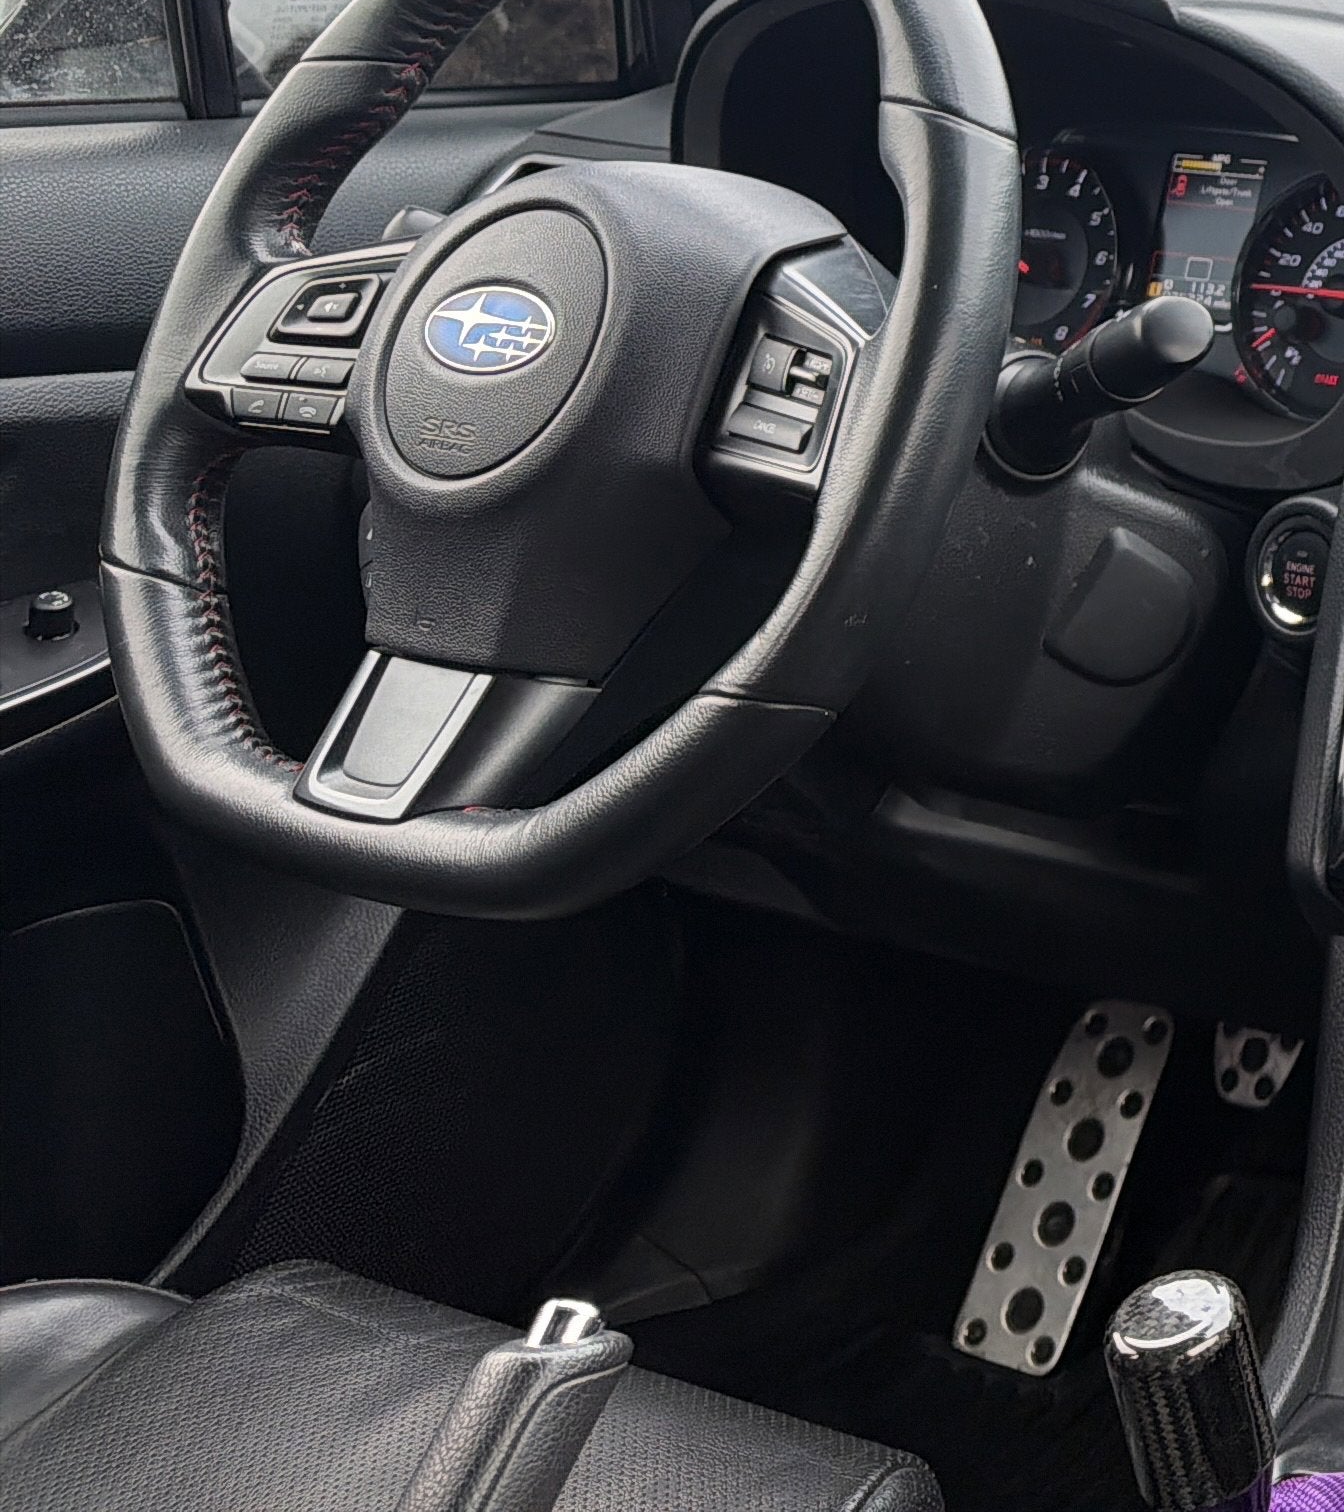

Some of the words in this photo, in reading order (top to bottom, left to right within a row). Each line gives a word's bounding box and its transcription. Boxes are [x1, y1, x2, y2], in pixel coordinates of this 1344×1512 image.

[1036, 174, 1050, 190] 3
[1089, 211, 1103, 227] 5
[1301, 221, 1324, 235] 40
[1095, 250, 1109, 266] 6
[1278, 252, 1302, 267] 20
[1081, 293, 1097, 309] 7
[420, 415, 477, 438] SRS
[1286, 560, 1315, 576] ENGINE
[1283, 572, 1316, 589] START
[1285, 585, 1313, 600] STOP
